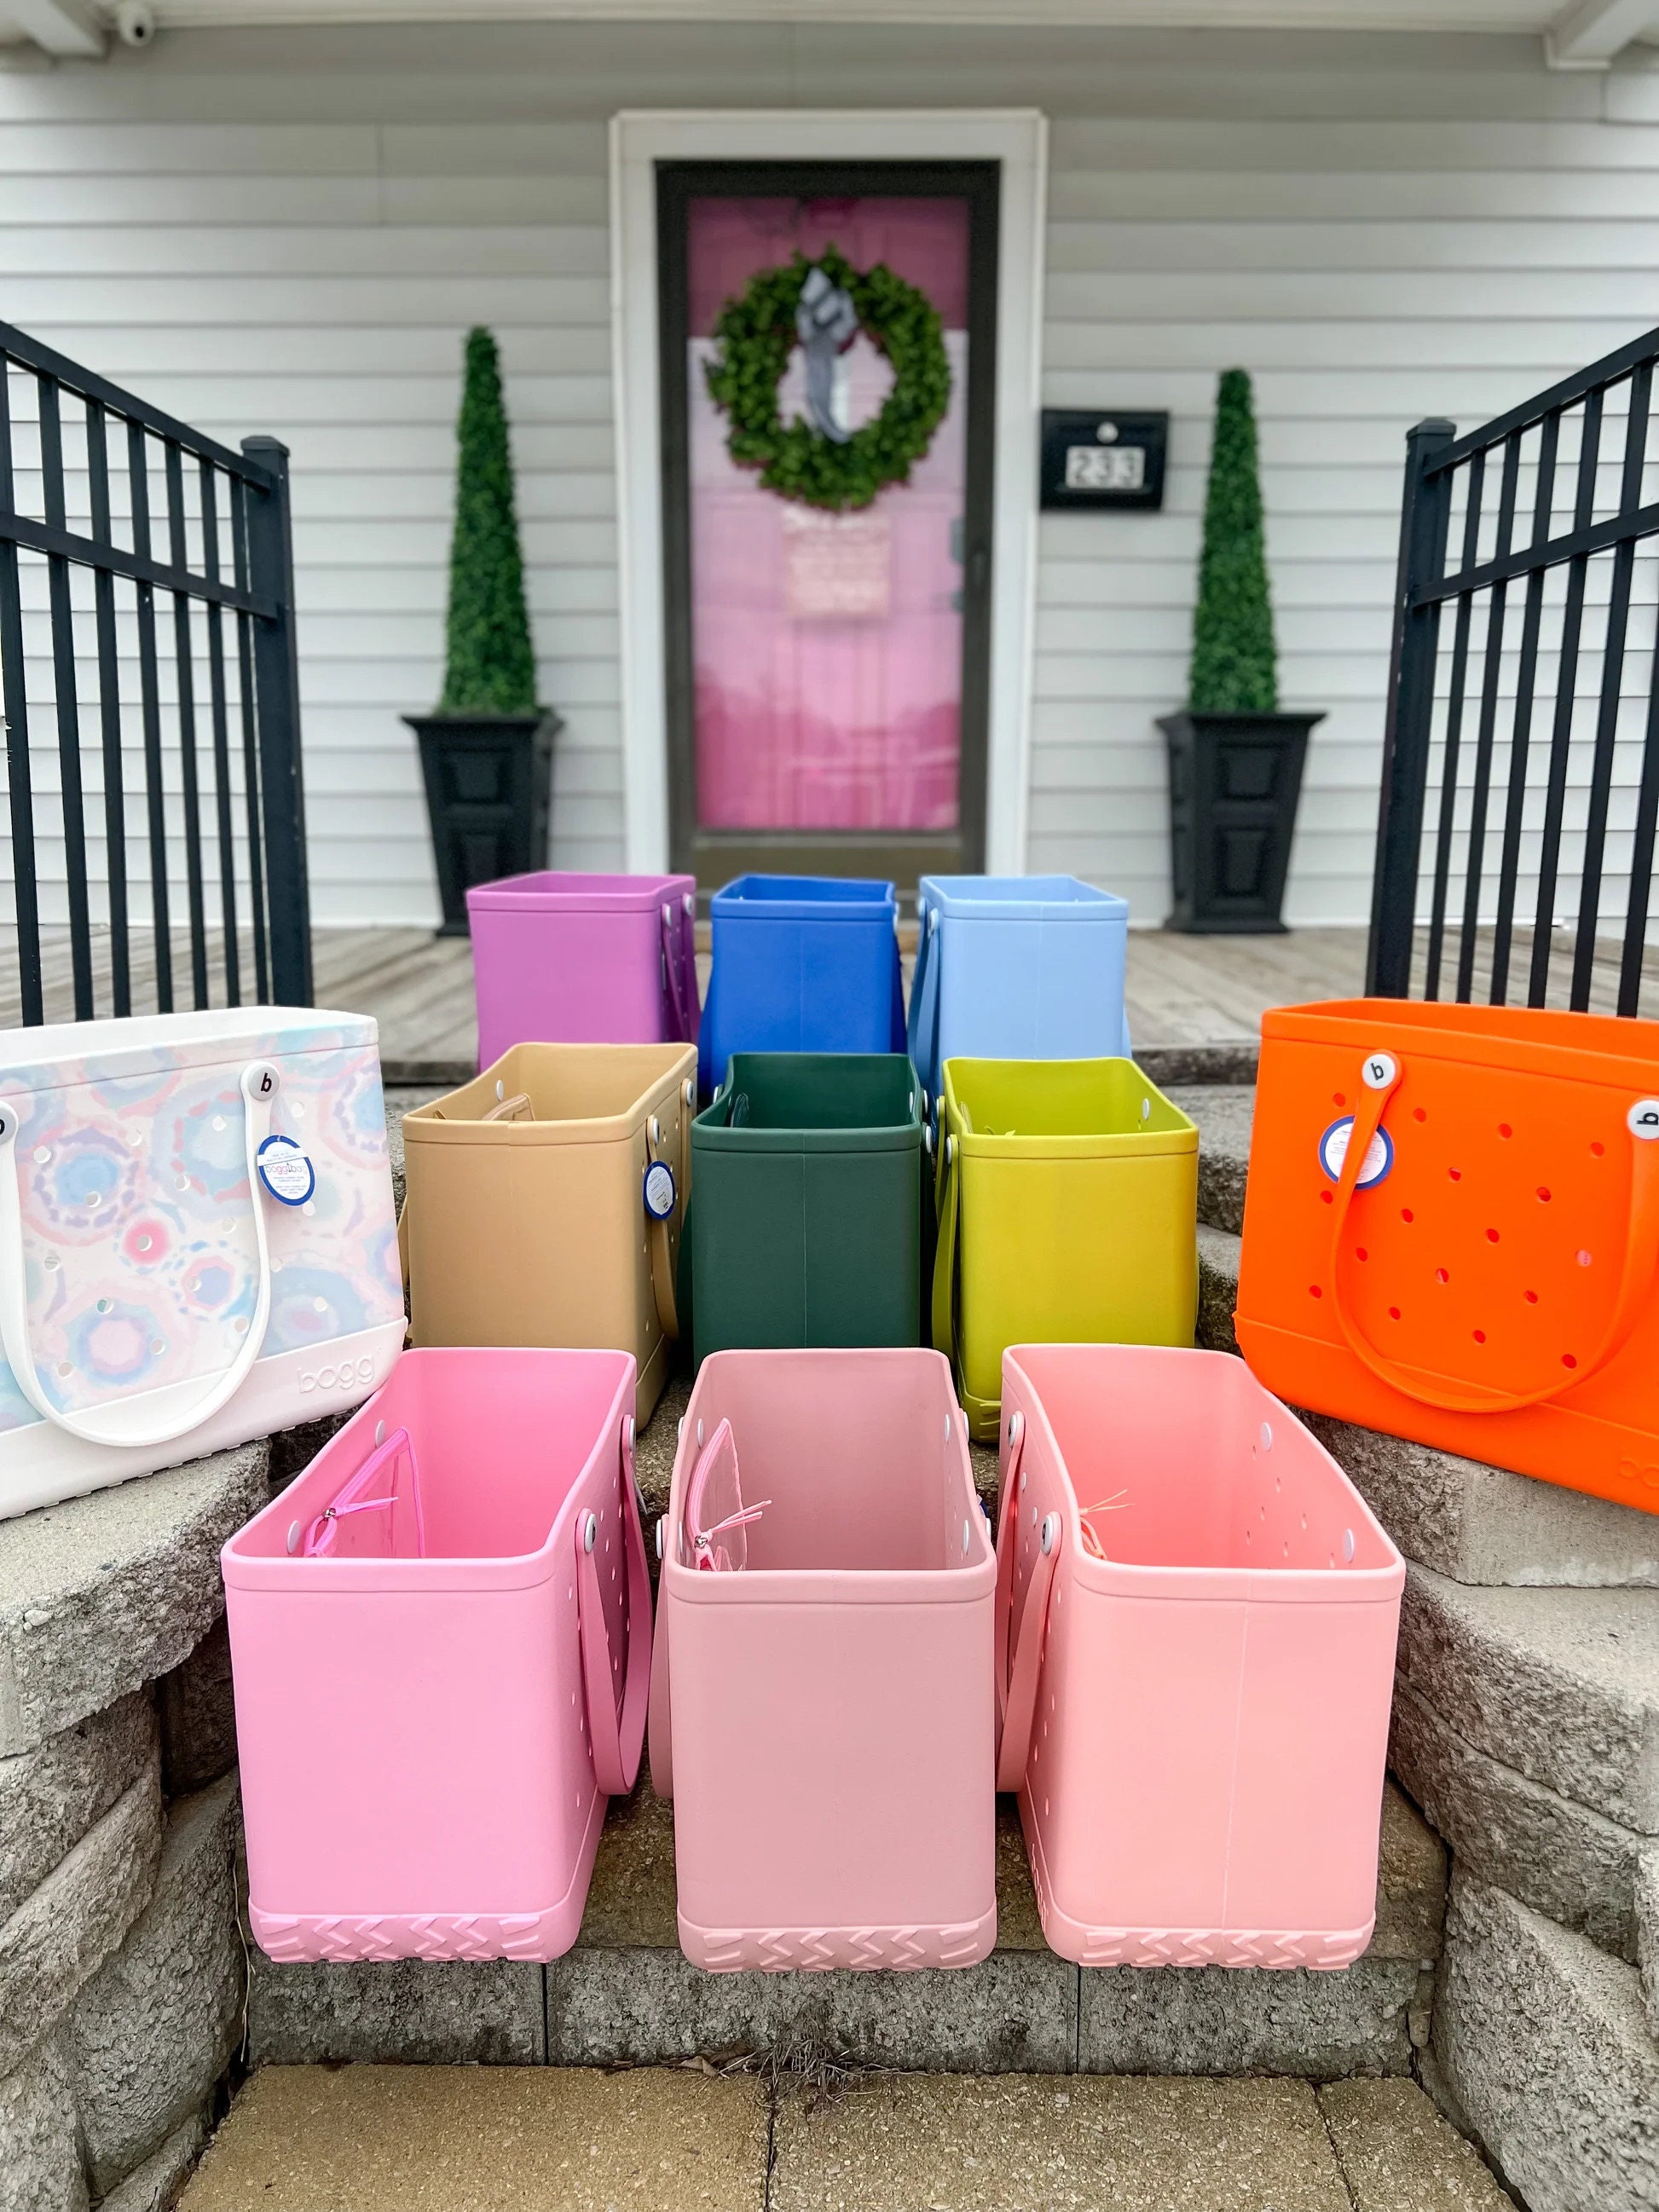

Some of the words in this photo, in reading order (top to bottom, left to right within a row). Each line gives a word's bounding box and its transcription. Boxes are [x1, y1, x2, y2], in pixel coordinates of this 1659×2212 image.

[1370, 1062, 1384, 1081] b
[260, 1072, 272, 1093] b
[297, 1354, 374, 1395] bogg
